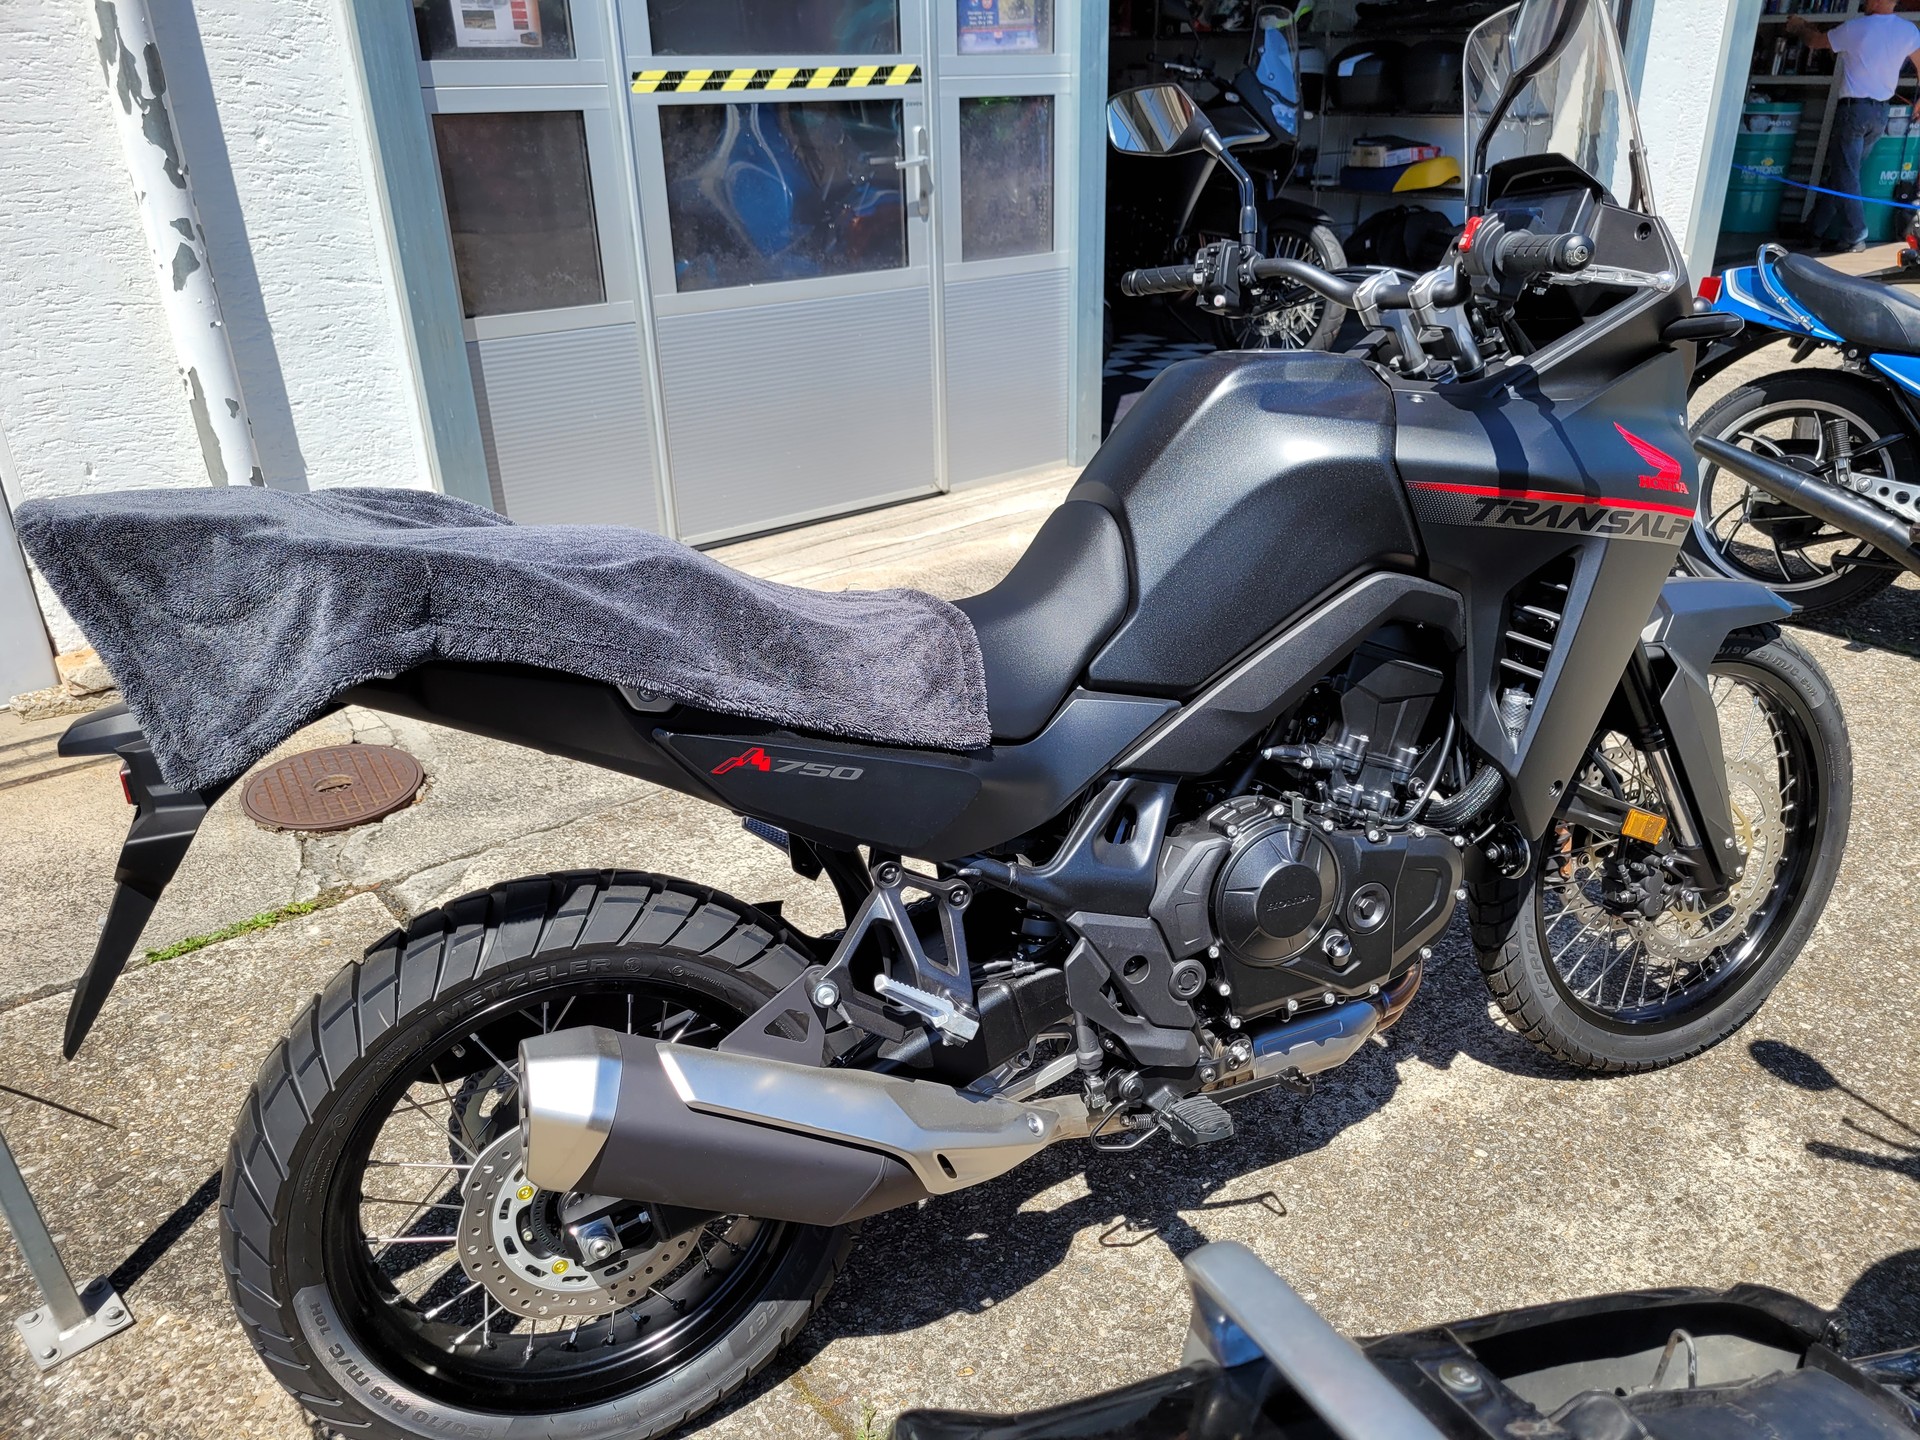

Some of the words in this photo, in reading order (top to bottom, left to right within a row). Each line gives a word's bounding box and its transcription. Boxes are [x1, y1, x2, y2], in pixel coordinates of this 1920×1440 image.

[1638, 475, 1690, 495] HONDA
[1472, 497, 1690, 540] TRANSALP
[774, 759, 864, 781] 750
[1266, 893, 1315, 912] HONDA
[435, 957, 613, 1026] METZELER
[309, 1301, 332, 1337] 70H
